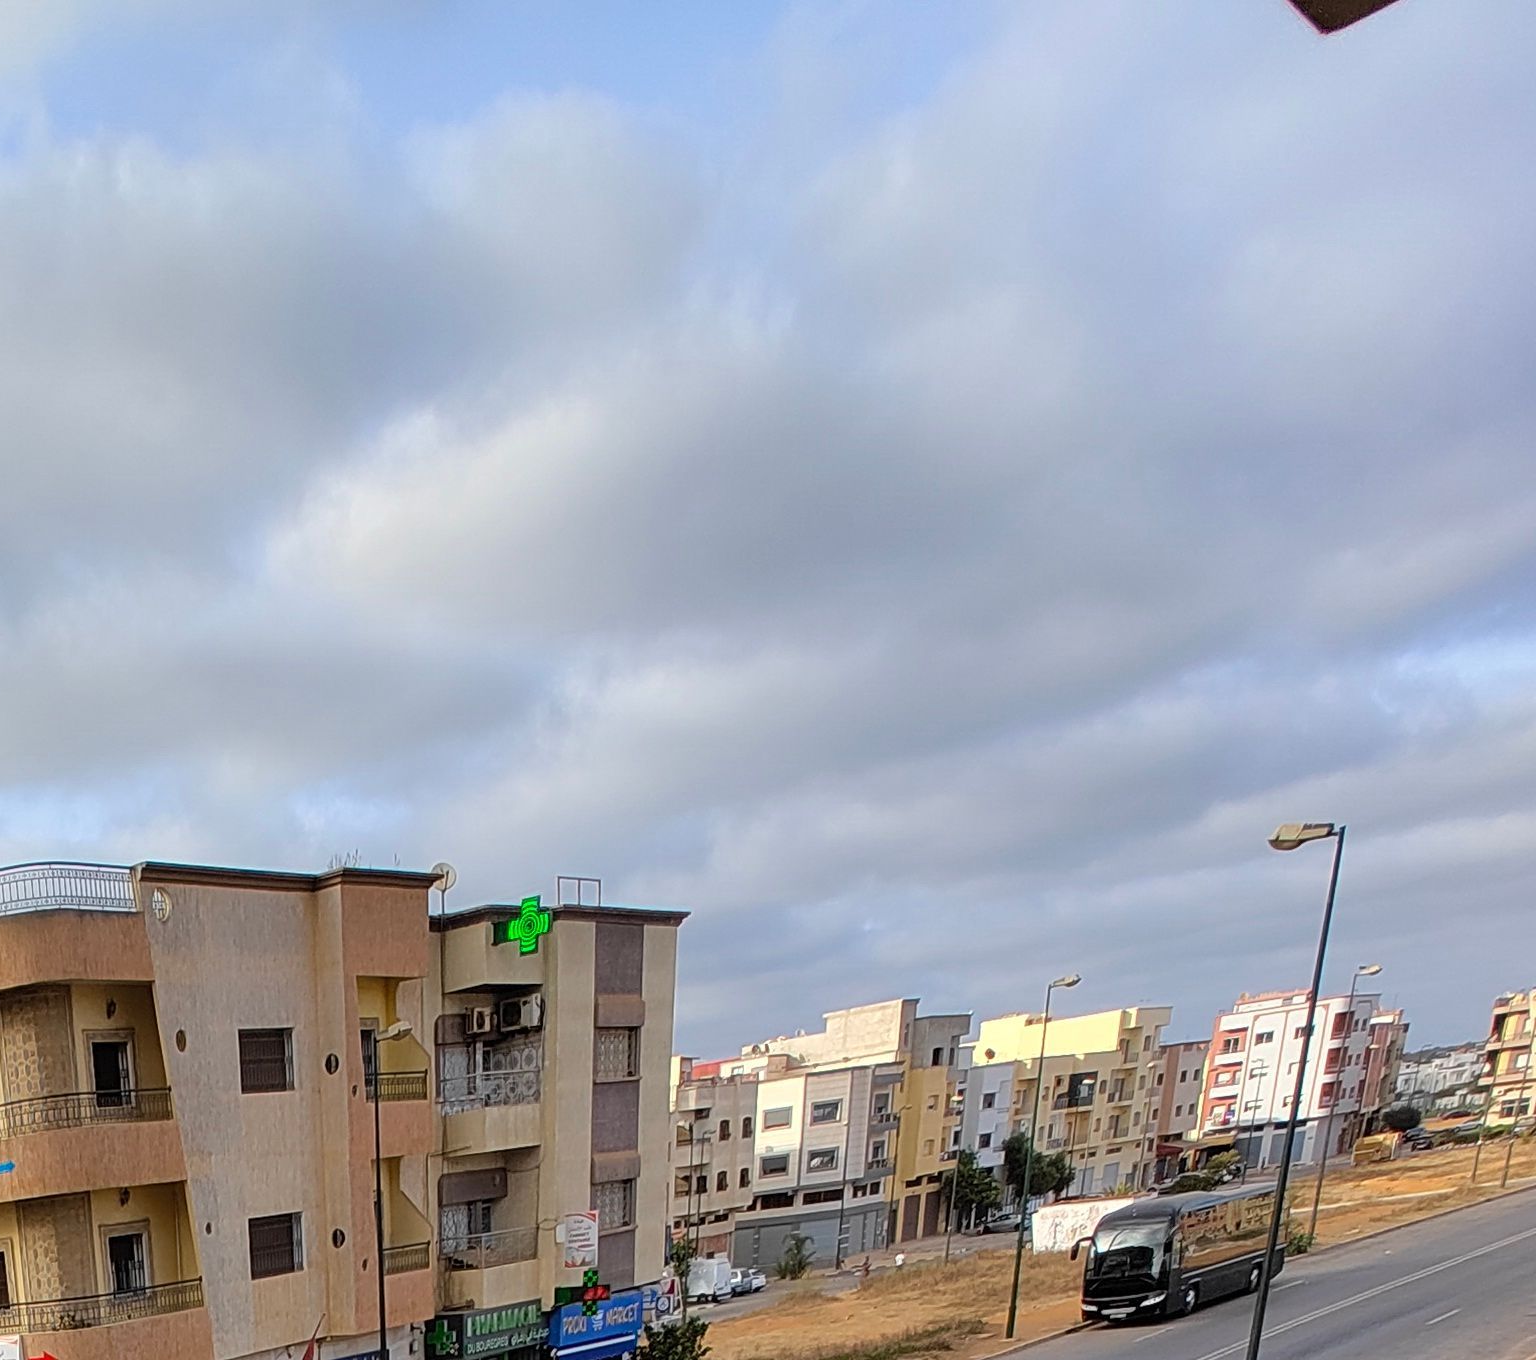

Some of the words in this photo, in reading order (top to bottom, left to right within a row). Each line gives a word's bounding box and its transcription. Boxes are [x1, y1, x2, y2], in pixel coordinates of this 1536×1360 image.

[562, 1315, 587, 1336] PROXI
[606, 1302, 640, 1328] MARKET
[467, 1343, 476, 1354] DU
